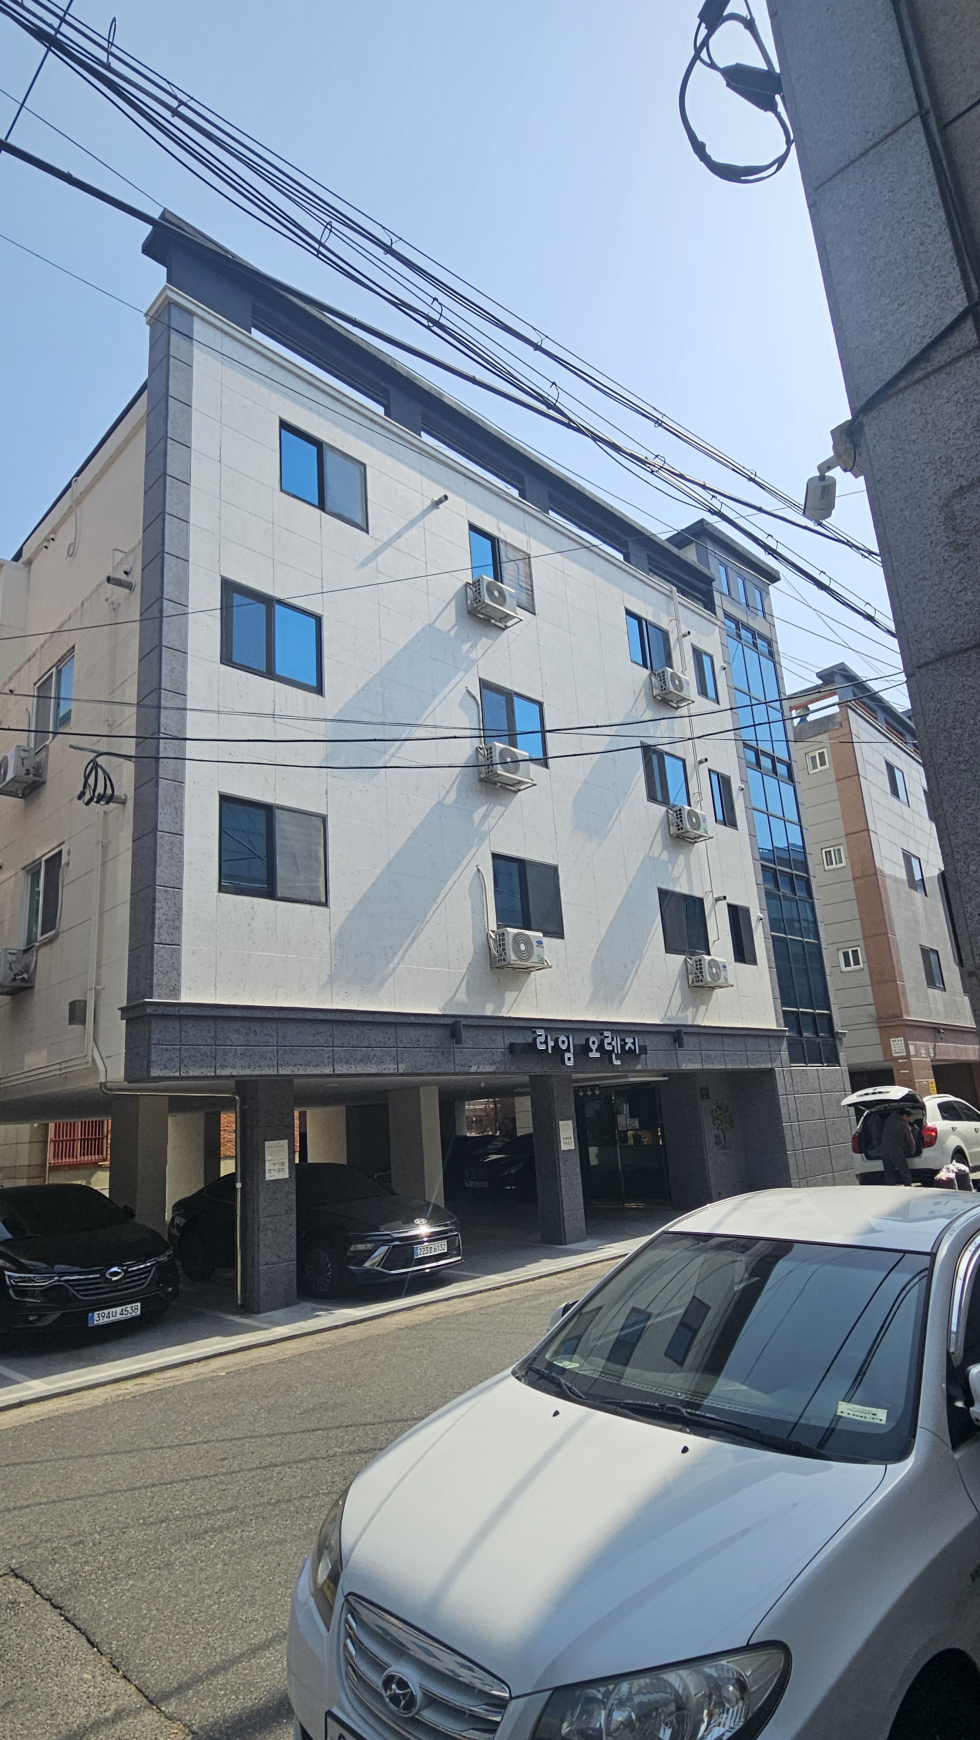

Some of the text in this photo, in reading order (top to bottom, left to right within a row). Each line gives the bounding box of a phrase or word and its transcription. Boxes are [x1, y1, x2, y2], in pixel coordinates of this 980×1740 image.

[535, 1028, 640, 1066] 라임 오렌지
[119, 1304, 139, 1317] 4538
